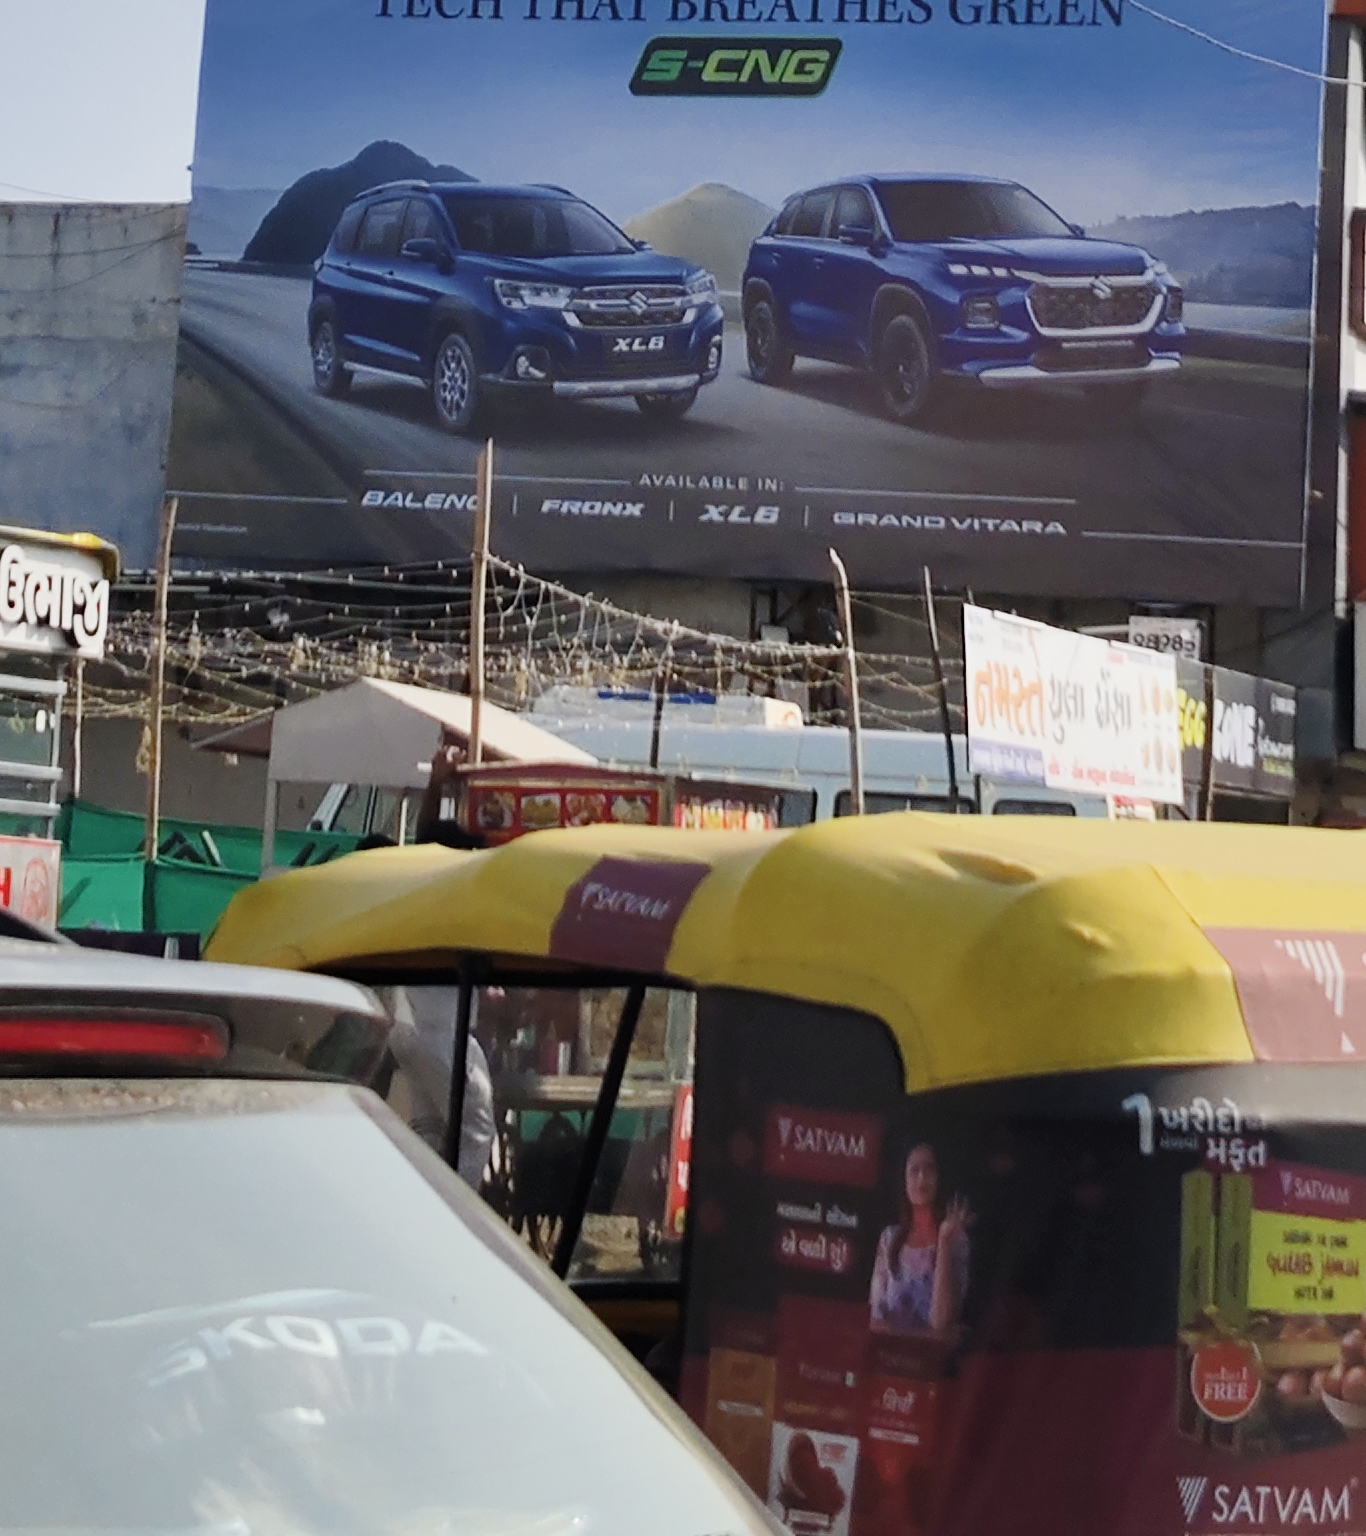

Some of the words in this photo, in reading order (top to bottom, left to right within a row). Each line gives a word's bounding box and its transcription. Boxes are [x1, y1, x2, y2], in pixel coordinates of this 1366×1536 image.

[641, 49, 830, 84] S-CNG
[639, 473, 749, 491] AVAILABLE
[540, 497, 646, 517] FRONX
[697, 503, 781, 524] XL6
[833, 510, 946, 529] GRAND
[949, 516, 1068, 536] VITARA
[794, 1124, 867, 1158] SATVAM
[1293, 1179, 1351, 1205] SATVAM
[1204, 1381, 1249, 1401] FREE
[1212, 1484, 1352, 1525] SATVAM
